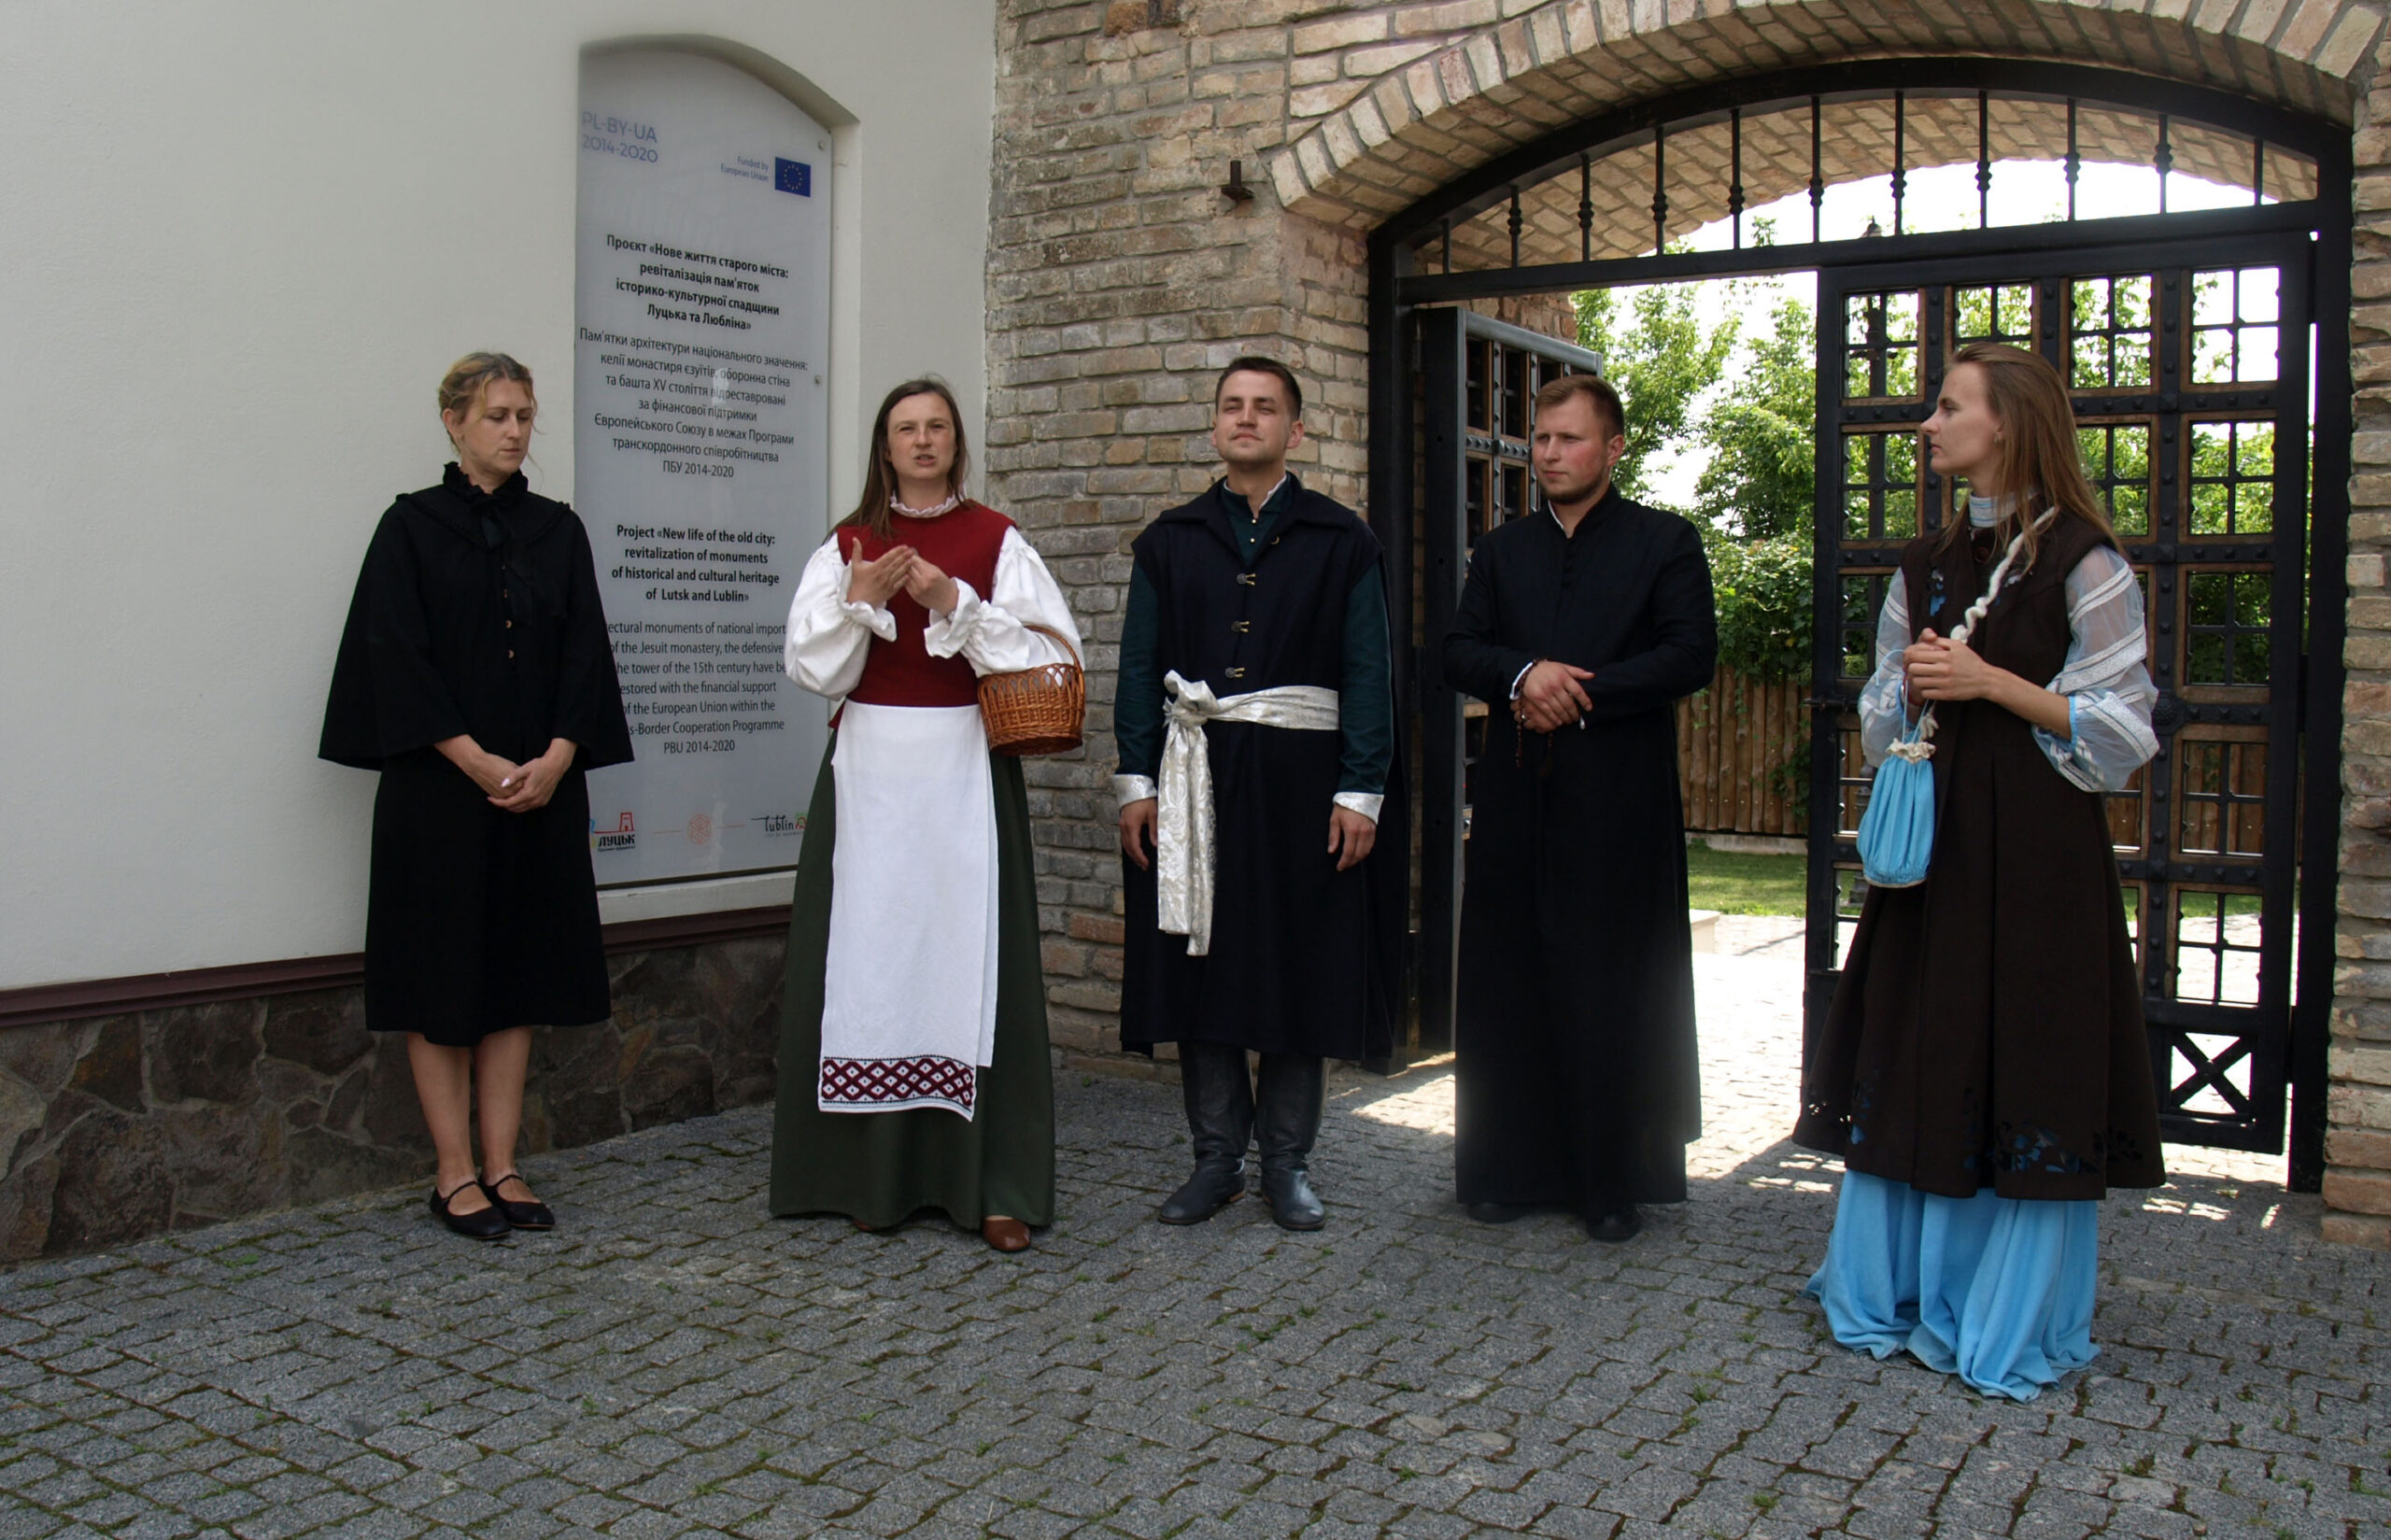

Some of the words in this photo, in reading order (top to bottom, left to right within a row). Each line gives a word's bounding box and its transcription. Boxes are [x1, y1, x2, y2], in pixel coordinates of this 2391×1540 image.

[582, 111, 658, 143] PL-BY-UA
[583, 134, 658, 163] 2014-2020
[607, 234, 646, 252] Проєкт
[649, 243, 682, 260] «Нове
[685, 250, 716, 265] життя
[718, 258, 757, 275] старого
[759, 263, 788, 278] міста:
[640, 262, 712, 286] ревіталізація
[714, 277, 759, 292] пам'яток
[615, 277, 727, 308] історико-культурної
[729, 298, 780, 316] спадщини
[647, 304, 686, 320] Луцька
[689, 313, 700, 322] та
[702, 312, 752, 331] Любліна»
[580, 327, 628, 346] Пам'ятки
[630, 337, 690, 356] архітектури
[692, 346, 762, 365] національного
[764, 357, 808, 371] значення:
[601, 354, 625, 366] келії
[627, 358, 683, 374] монастиря
[720, 368, 767, 384] оборонна
[768, 374, 790, 388] стіна
[605, 374, 616, 386] та
[619, 374, 651, 390] башта
[653, 378, 667, 391] XV
[669, 384, 708, 397] століття
[638, 400, 649, 410] за
[652, 399, 706, 417] фінансової
[708, 406, 757, 421] підтримки
[595, 413, 673, 432] Європейського
[675, 421, 706, 439] Союзу
[708, 427, 714, 437] в
[716, 429, 747, 440] межах
[749, 429, 795, 445] Програми
[613, 437, 701, 456] транскордонного
[703, 445, 779, 463] співробітництва
[663, 459, 683, 473] ПБУ
[685, 462, 734, 478] 2014-2020
[616, 524, 655, 539] Project
[657, 527, 686, 539] «New
[687, 528, 704, 540] life
[706, 529, 716, 540] of
[718, 530, 735, 542] the
[737, 531, 753, 544] old
[755, 531, 775, 545] city:
[625, 547, 695, 562] revitalization
[697, 549, 708, 562] of
[709, 552, 769, 564] monuments
[612, 566, 623, 579] of
[625, 566, 674, 580] historical
[676, 569, 696, 581] and
[698, 570, 737, 584] cultural
[739, 571, 780, 586] heritage
[645, 587, 657, 601] of
[661, 588, 689, 601] Lutsk
[691, 589, 711, 602] and
[713, 589, 749, 603] Lublin»
[608, 621, 642, 633] ectural
[644, 623, 703, 634] monuments
[705, 621, 715, 633] of
[716, 622, 755, 635] national
[756, 622, 786, 637] import
[621, 641, 638, 654] the
[640, 641, 668, 654] Jesuit
[670, 643, 722, 657] monastery,
[724, 641, 740, 653] the
[742, 641, 784, 654] defensive
[616, 661, 630, 674] he
[631, 663, 659, 674] tower
[662, 661, 672, 673] of
[674, 661, 690, 673] the
[694, 661, 714, 673] 15th
[715, 661, 751, 676] century
[753, 660, 774, 672] have
[620, 682, 657, 694] estored
[659, 680, 681, 693] with
[683, 680, 699, 692] the
[700, 679, 741, 692] financial
[742, 679, 777, 694] support
[633, 702, 650, 714] the
[652, 700, 698, 716] European
[700, 699, 728, 713] Union
[729, 699, 758, 712] within
[760, 699, 776, 711] the
[630, 722, 671, 735] s-Border
[672, 718, 730, 736] Cooperation
[732, 719, 785, 733] Programme
[663, 740, 684, 754] PBU
[686, 740, 736, 754] 2014-2020
